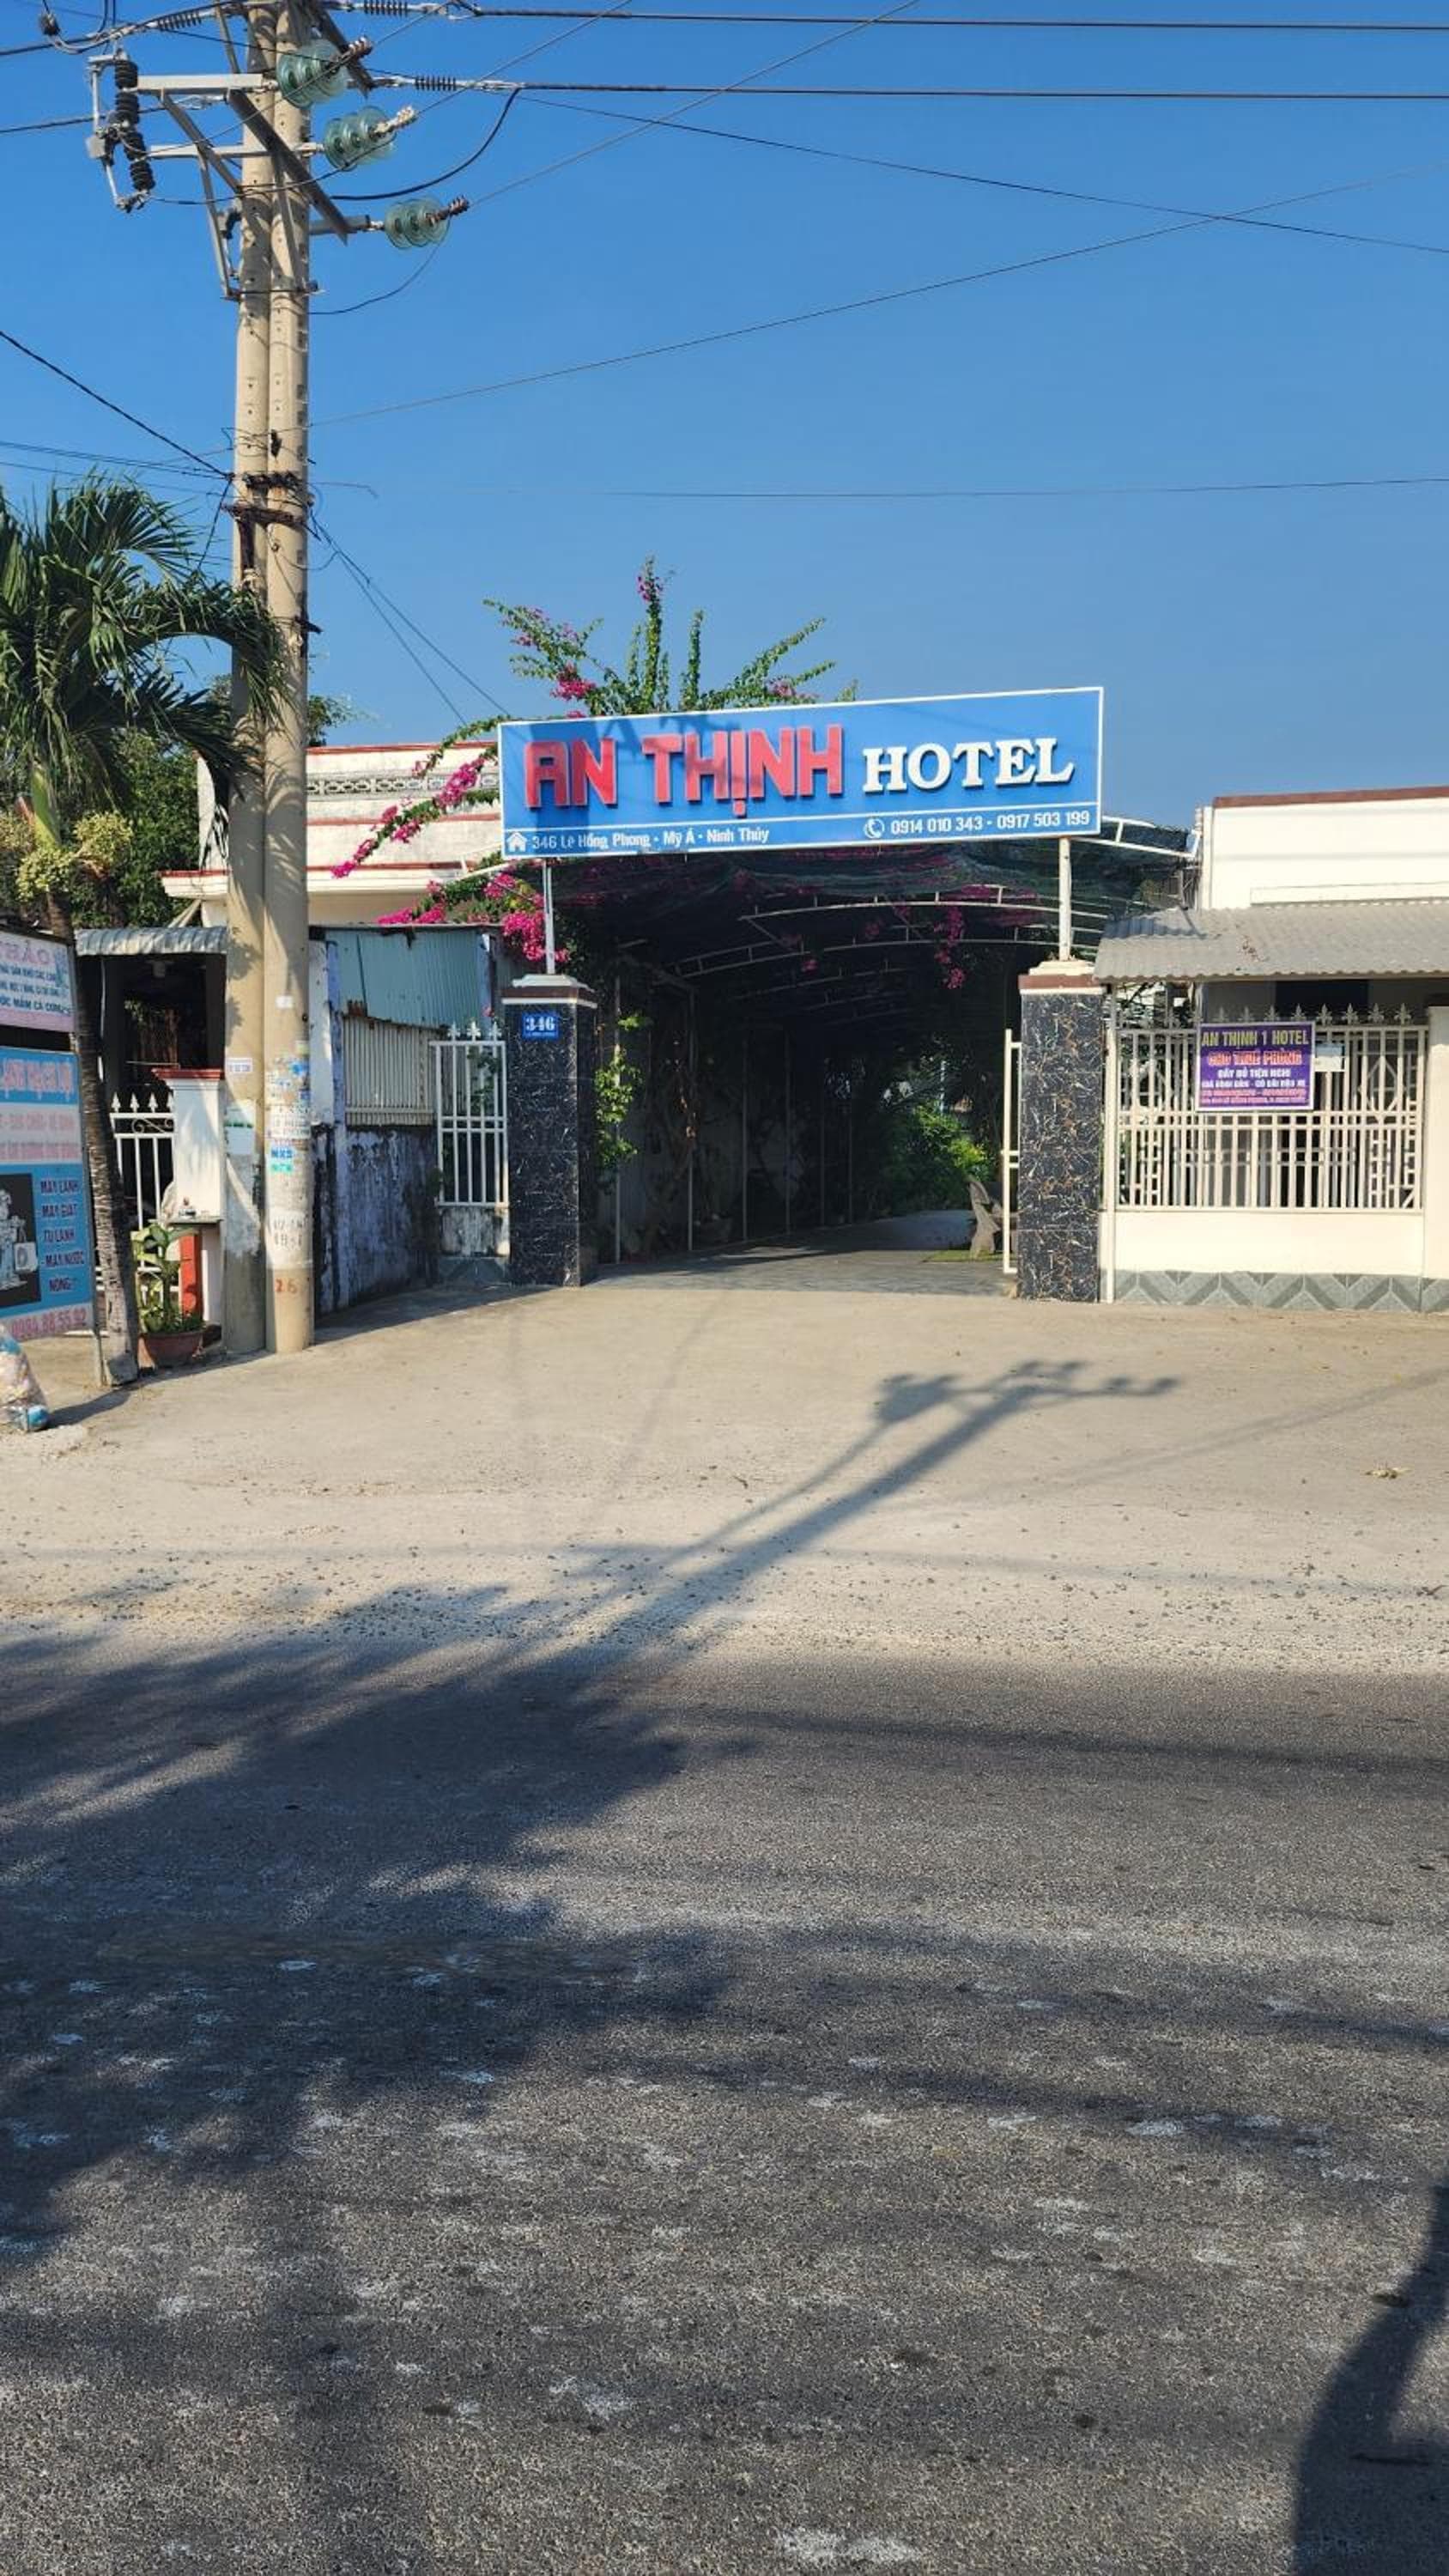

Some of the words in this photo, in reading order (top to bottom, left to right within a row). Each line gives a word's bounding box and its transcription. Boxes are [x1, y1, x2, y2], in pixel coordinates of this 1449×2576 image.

[524, 738, 617, 809] AN
[641, 724, 845, 817] THỊNH
[862, 738, 1075, 793] HOTEL
[890, 817, 923, 835] 0914
[927, 817, 952, 832] 010
[955, 816, 983, 831] 343
[997, 813, 1028, 829] 0917
[1033, 811, 1061, 828] 503
[1065, 810, 1090, 826] 199
[531, 835, 556, 850] 346
[578, 830, 609, 851] Hồng
[611, 830, 651, 850] Phong
[663, 829, 682, 847] Mỹ
[685, 826, 695, 844] Á
[706, 828, 734, 844] Ninh
[525, 1016, 555, 1031] 346
[1202, 1031, 1219, 1047] AN
[1222, 1030, 1258, 1048] THỊNH
[1261, 1030, 1267, 1045] 1
[1272, 1030, 1309, 1045] HOTEL
